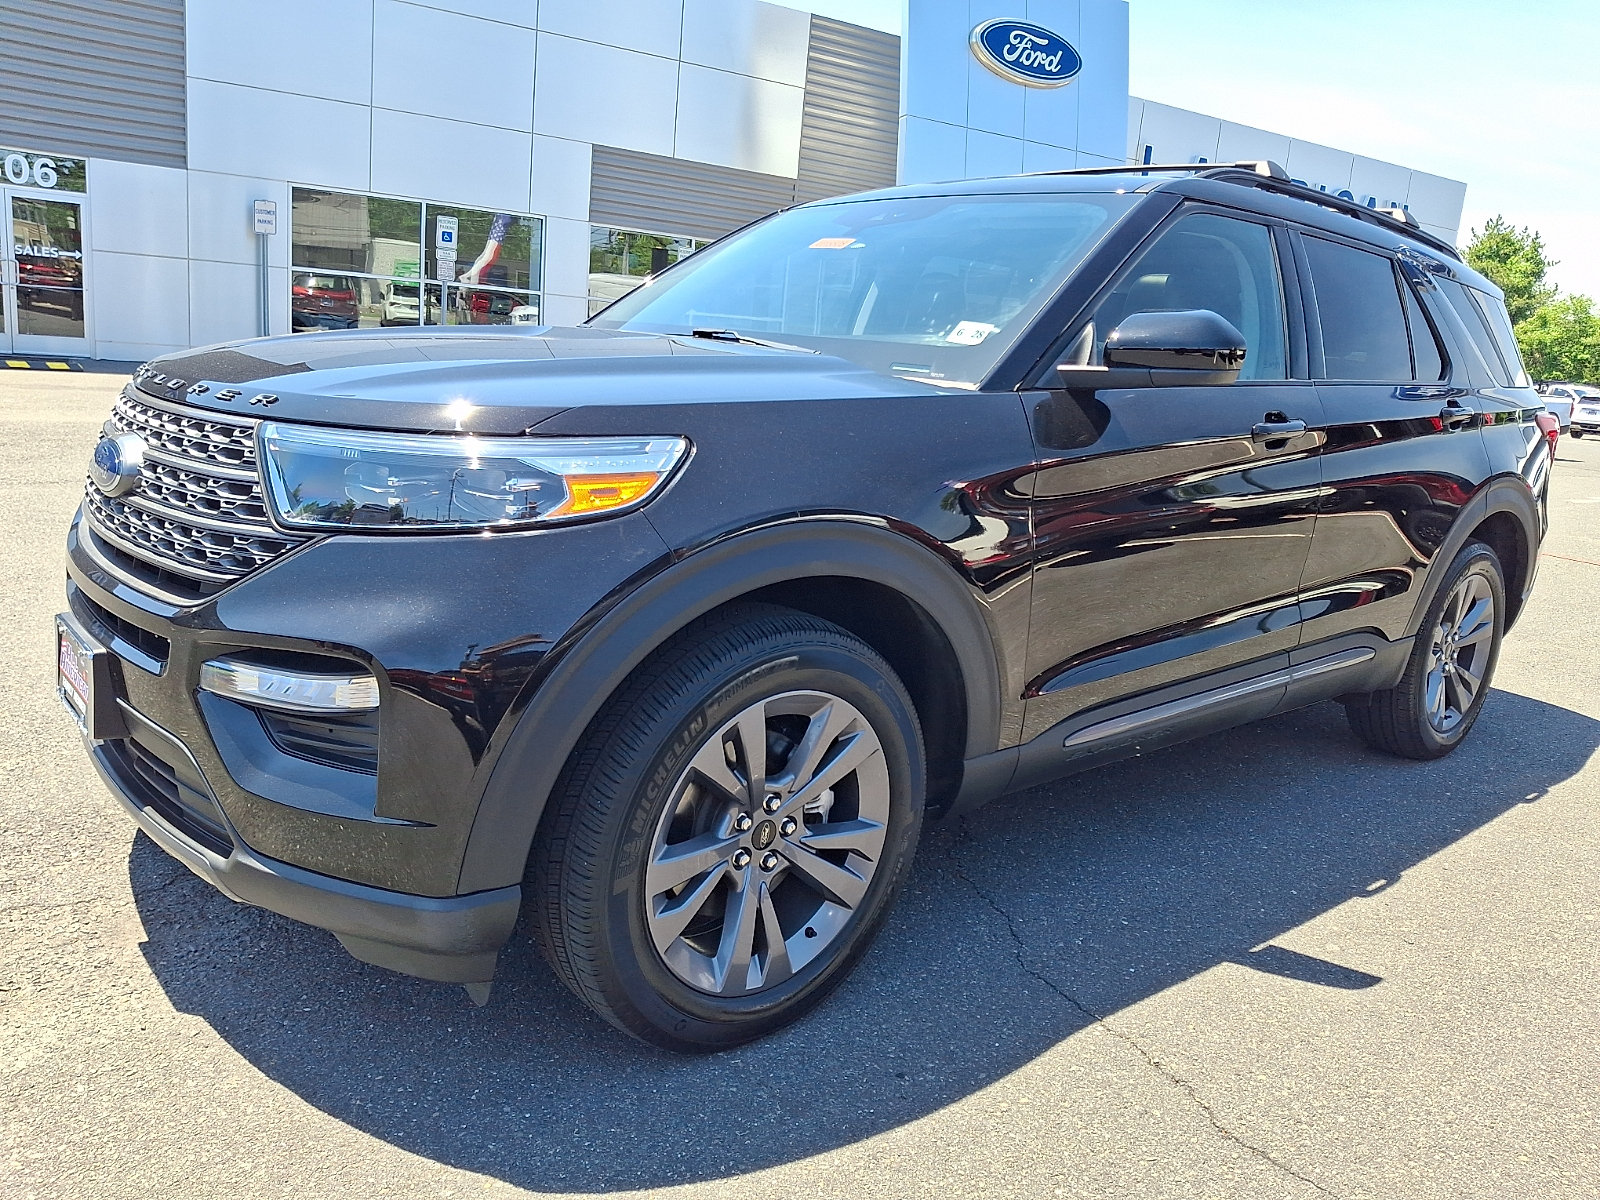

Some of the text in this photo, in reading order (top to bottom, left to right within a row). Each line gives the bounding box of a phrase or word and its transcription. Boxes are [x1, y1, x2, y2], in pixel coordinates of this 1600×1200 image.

[1003, 30, 1063, 73] Ford
[0, 153, 58, 188] 06
[15, 244, 59, 258] SALES
[632, 715, 704, 834] MICHELIN
